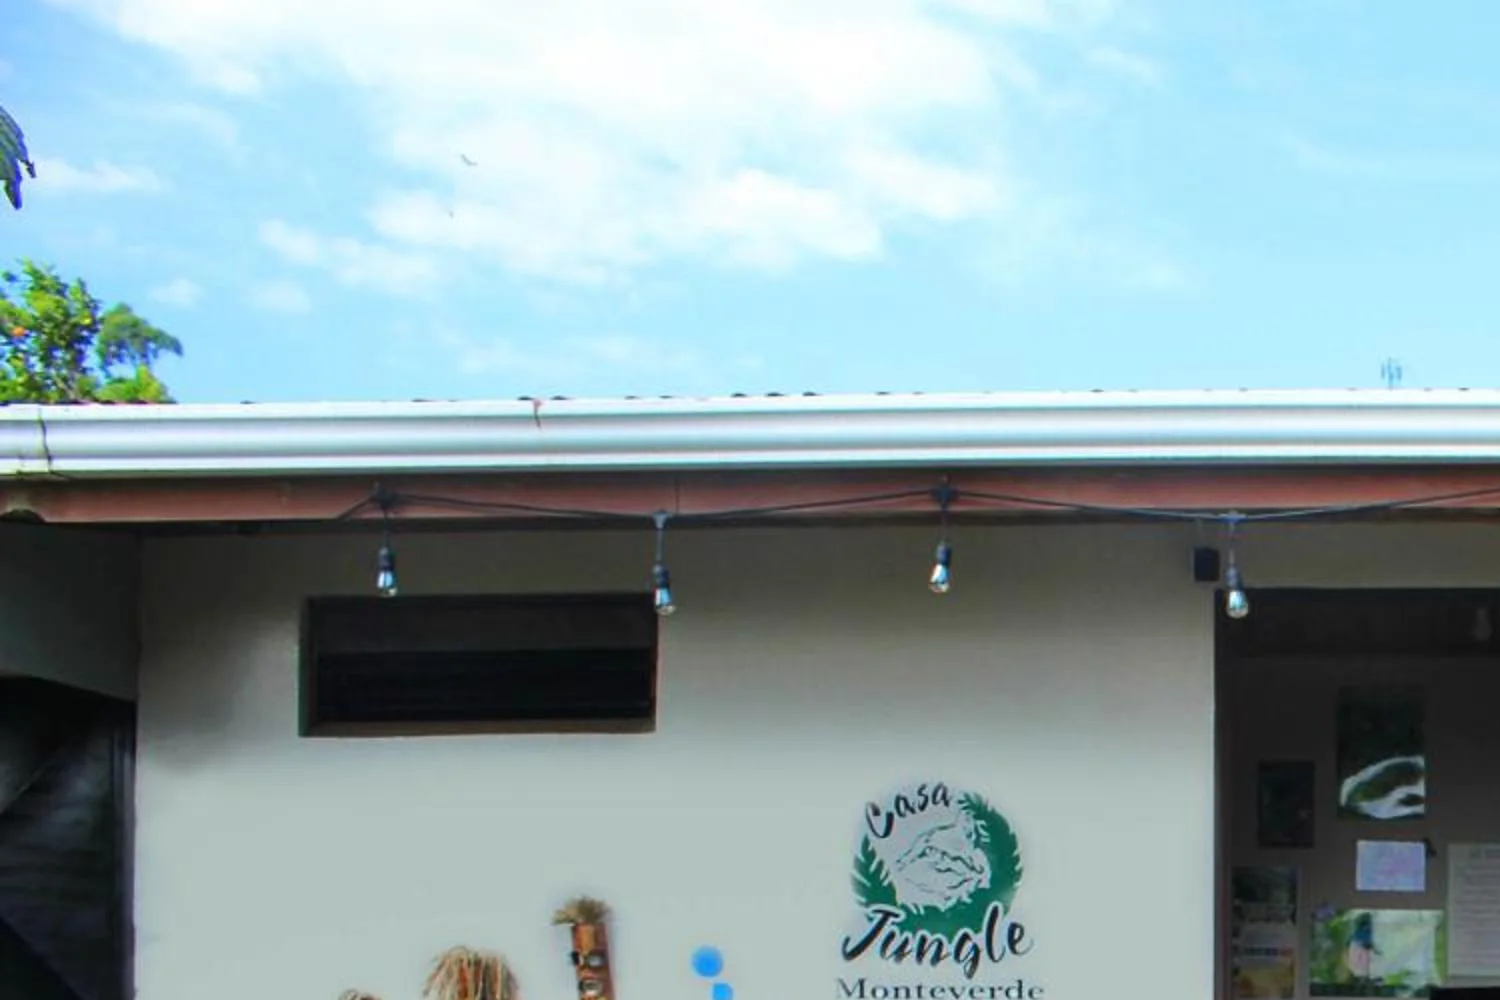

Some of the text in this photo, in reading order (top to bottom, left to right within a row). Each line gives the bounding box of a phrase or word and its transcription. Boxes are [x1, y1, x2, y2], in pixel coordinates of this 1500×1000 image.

[865, 782, 951, 839] Casa
[841, 901, 1035, 979] Jungle
[837, 978, 1045, 1000] Monteverde
